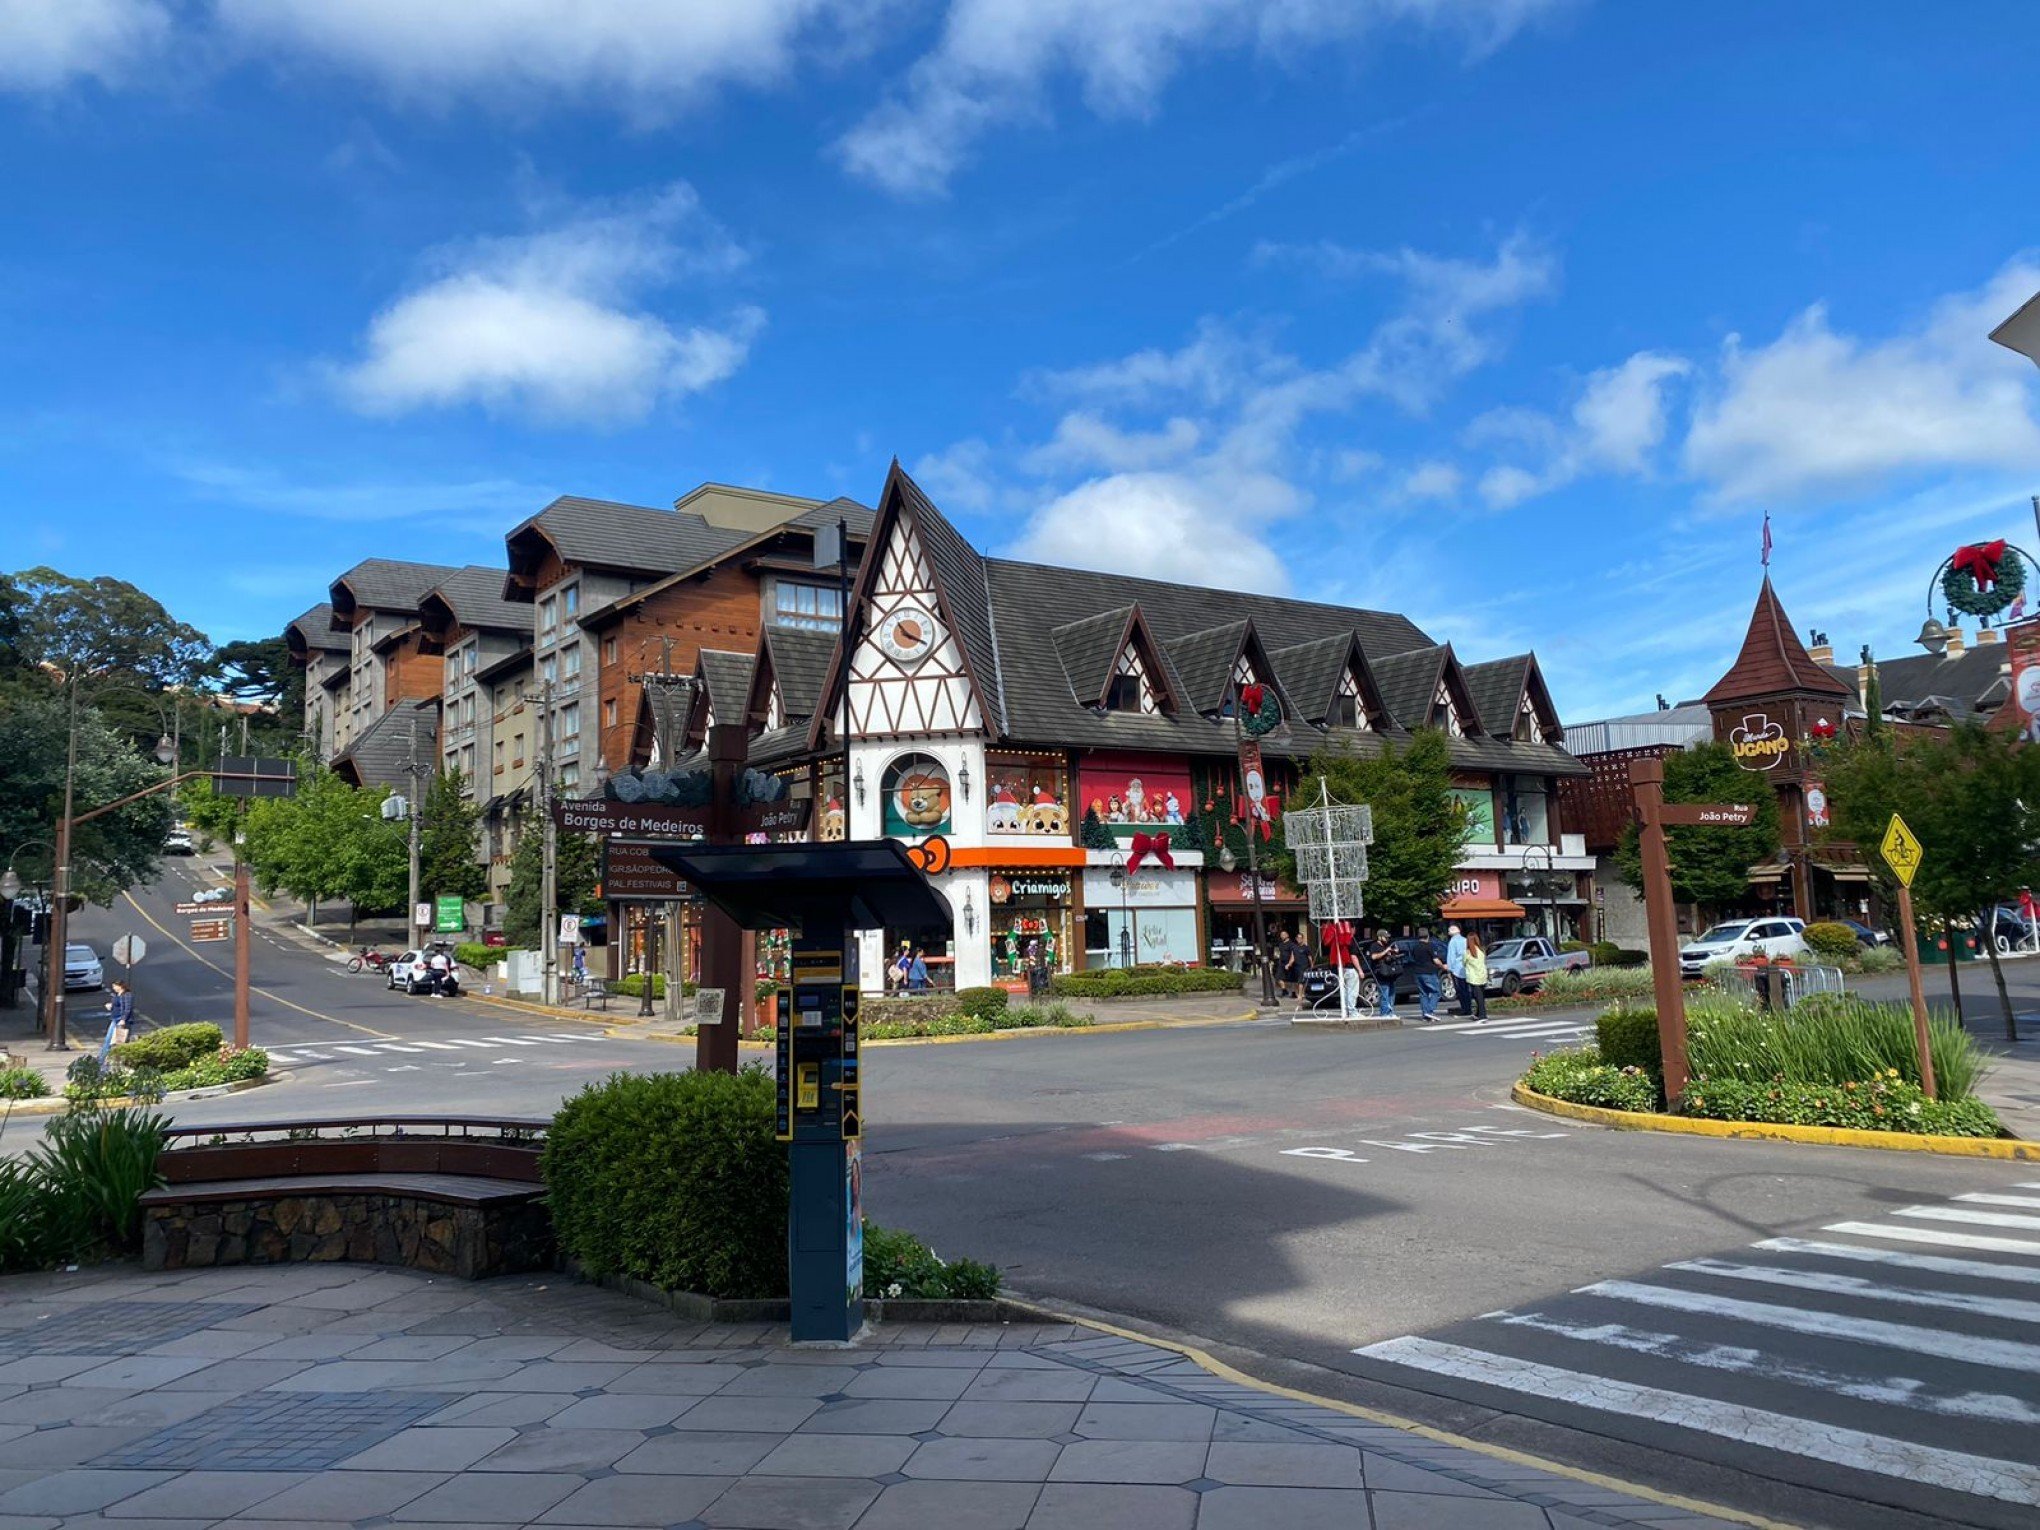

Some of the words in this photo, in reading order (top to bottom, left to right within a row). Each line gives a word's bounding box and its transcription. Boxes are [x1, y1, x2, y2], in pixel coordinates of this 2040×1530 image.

[560, 800, 606, 812] Avenida
[564, 812, 615, 831] Borges
[619, 816, 636, 830] de
[640, 818, 705, 834] Medeiros
[761, 811, 777, 827] João
[779, 811, 798, 825] Petry
[1699, 811, 1721, 821] João
[1723, 812, 1747, 823] Petry
[609, 847, 628, 857] RUA
[629, 847, 650, 857] COB
[1012, 879, 1072, 899] Criamigos
[1443, 879, 1480, 894] UPO
[1279, 1125, 1571, 1163] PARE
